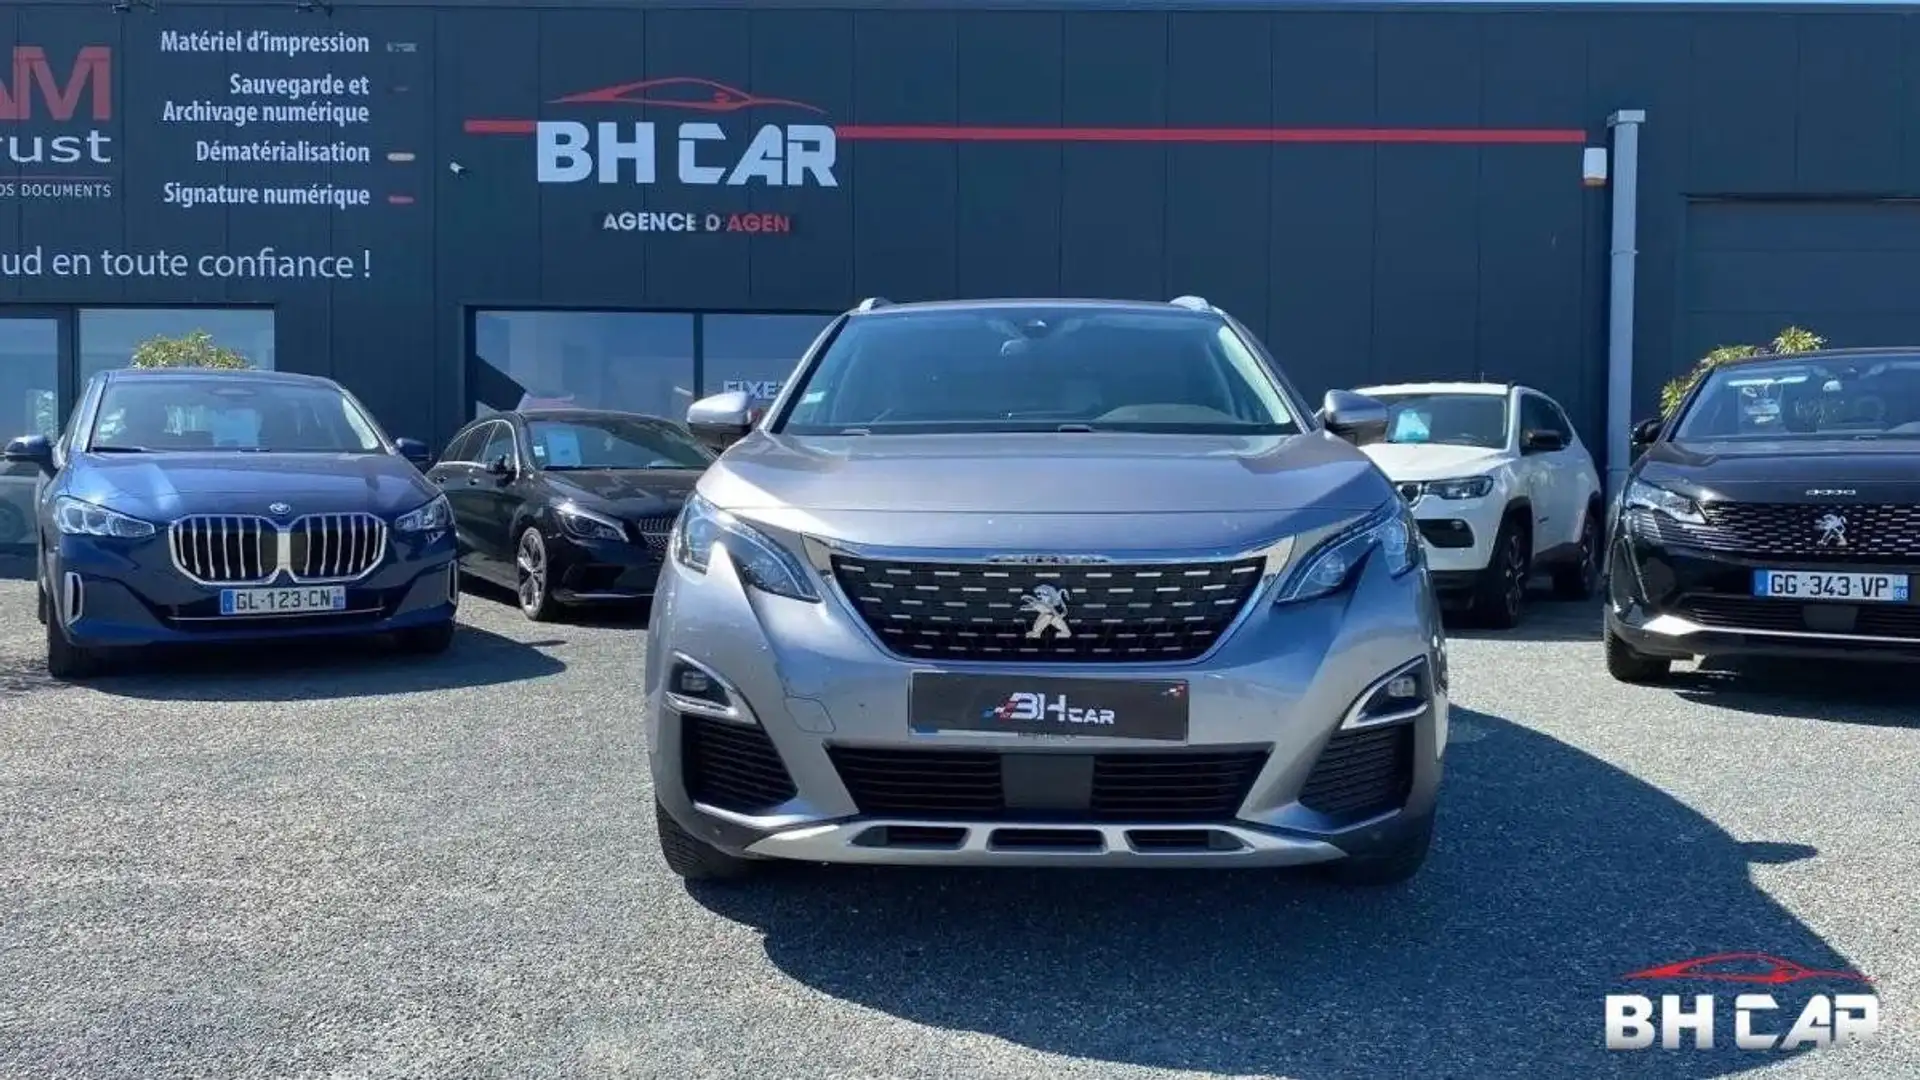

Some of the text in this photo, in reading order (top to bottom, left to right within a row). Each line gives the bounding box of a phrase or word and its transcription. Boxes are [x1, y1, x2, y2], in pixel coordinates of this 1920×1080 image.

[161, 30, 242, 52] Matériel
[230, 73, 369, 100] Sauvegarde et
[163, 100, 369, 127] Archivage numérique
[0, 130, 111, 163] ust
[197, 140, 370, 162] Dématérialisation
[537, 121, 838, 187] BH CAR
[21, 183, 111, 198] DOCUMENTS
[164, 183, 370, 210] Signature numérique
[603, 212, 696, 232] AGENCE
[53, 253, 90, 275] en
[101, 250, 188, 276] toute
[198, 247, 353, 278] confiance
[723, 380, 786, 400] FIXE
[1067, 708, 1115, 725] CAR
